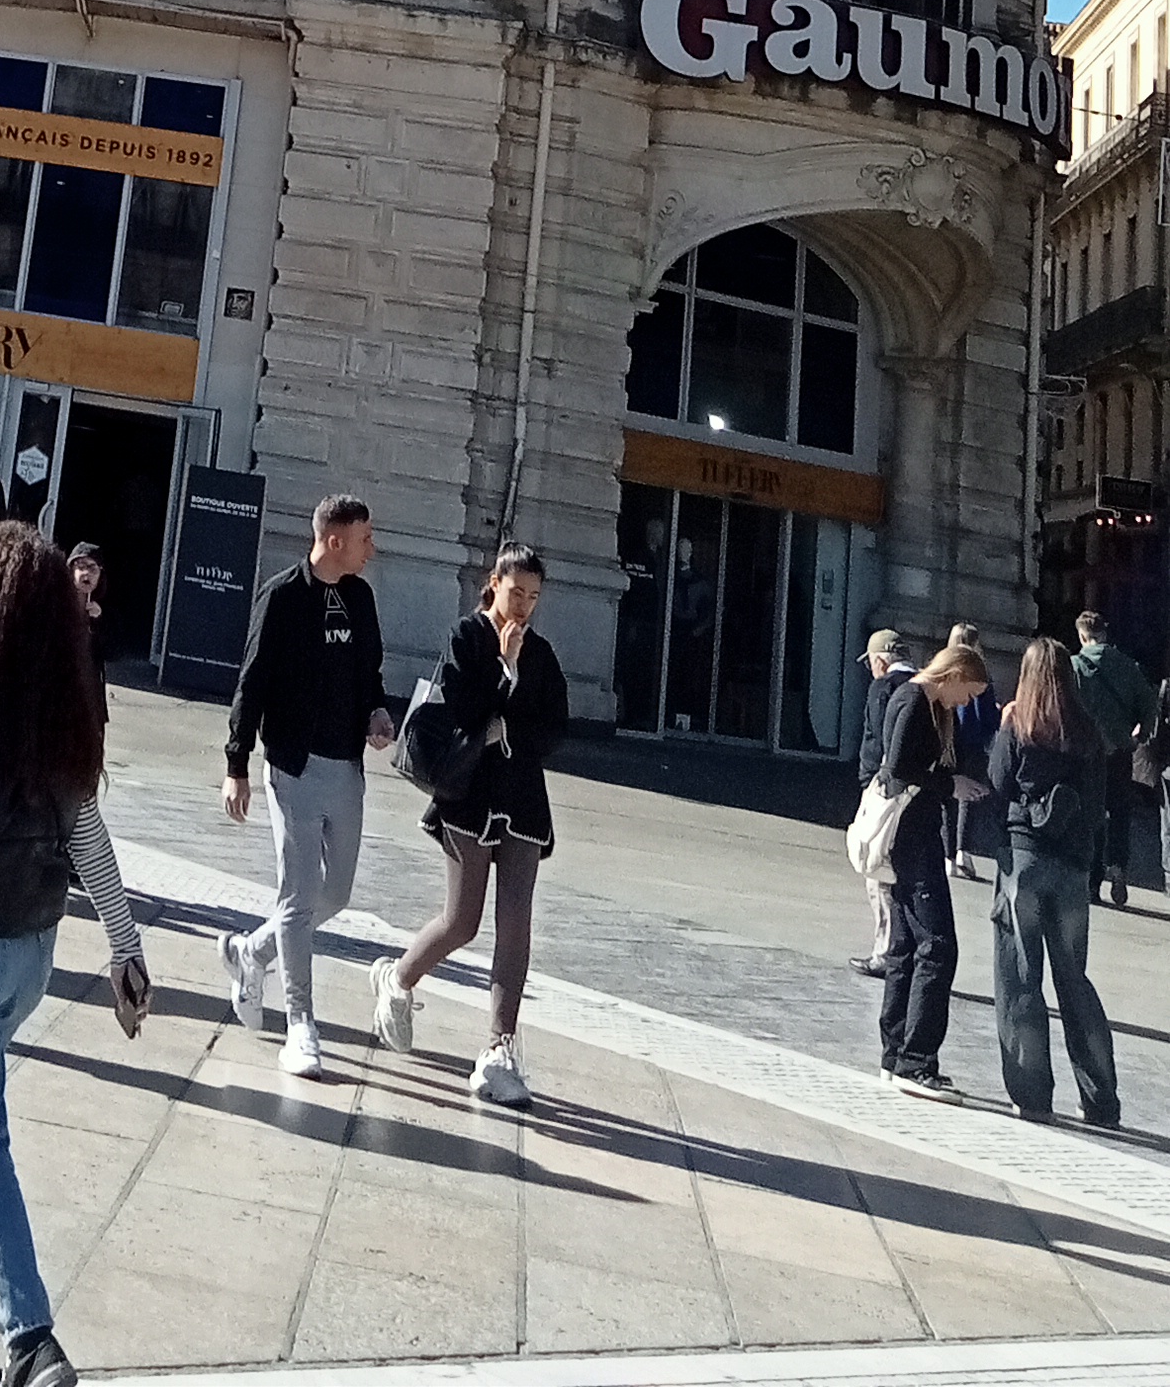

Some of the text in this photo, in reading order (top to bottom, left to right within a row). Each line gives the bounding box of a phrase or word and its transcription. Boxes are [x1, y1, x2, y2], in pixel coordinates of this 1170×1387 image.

[80, 135, 157, 160] DEPUIS
[166, 147, 214, 169] 1892
[191, 494, 226, 508] BOUTIQUE
[226, 501, 259, 514] OUVERTE
